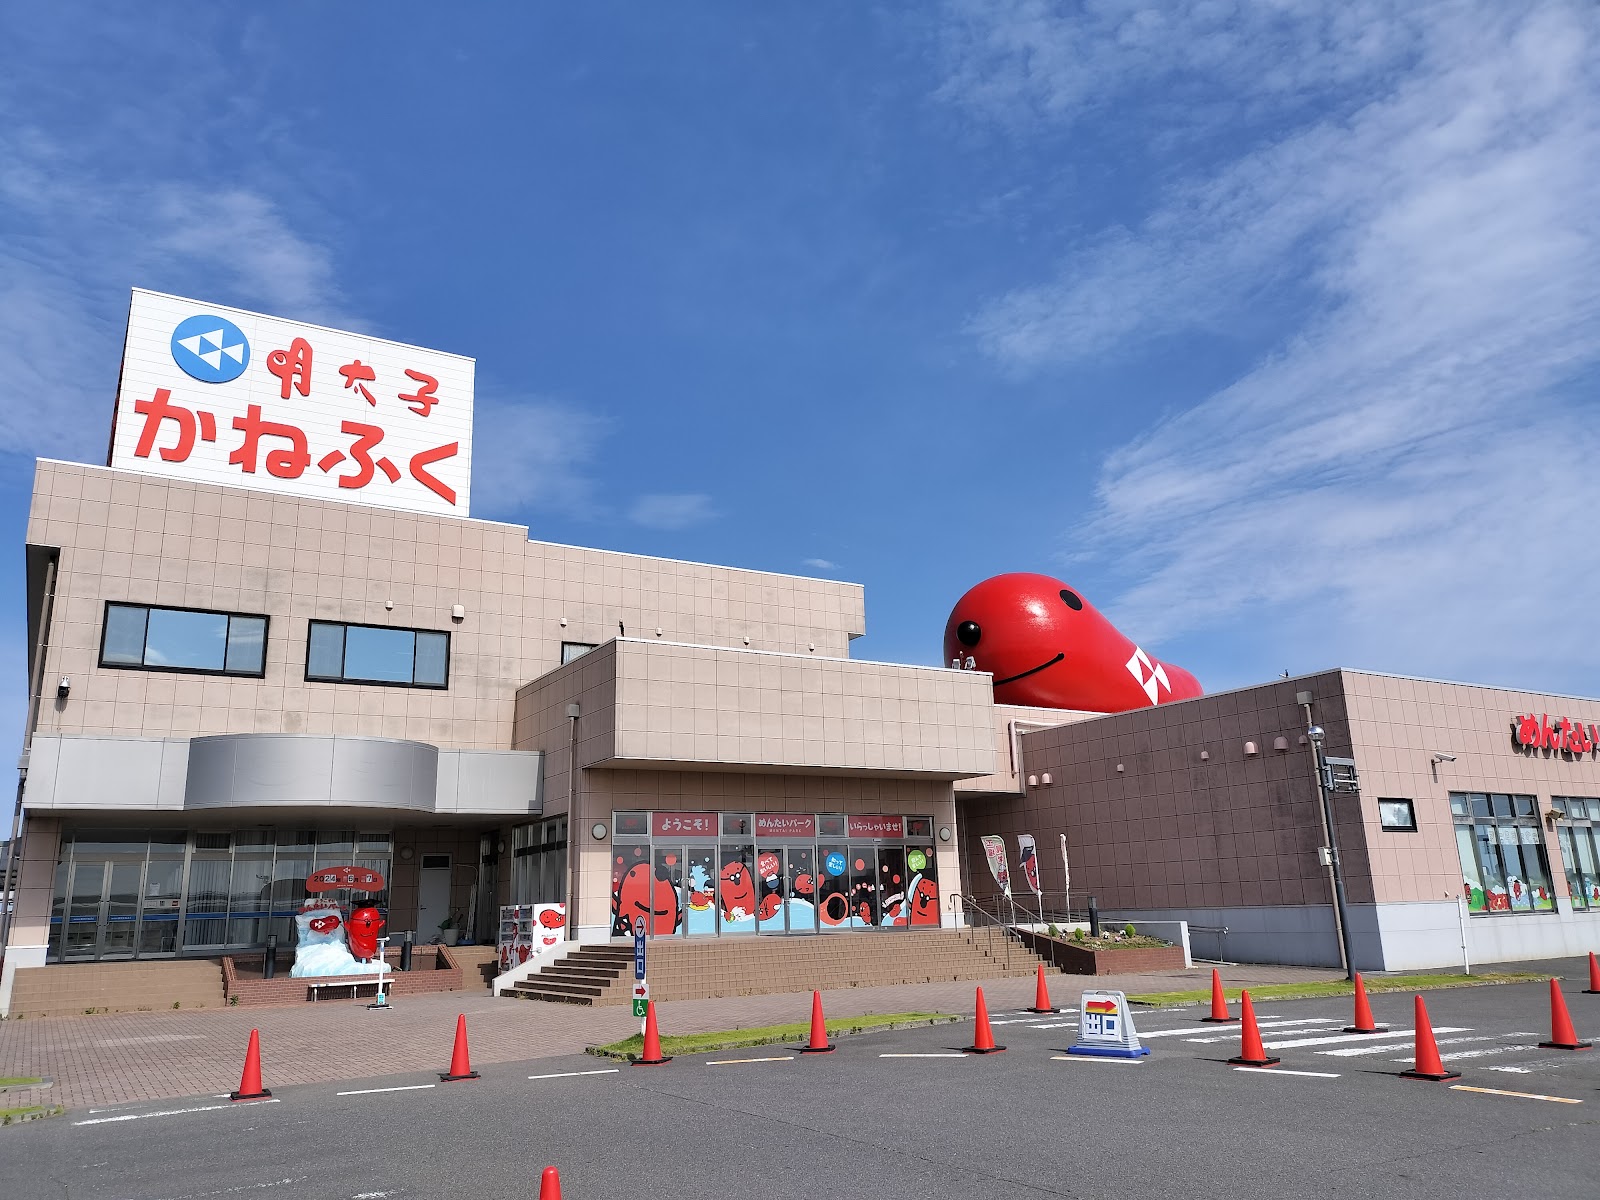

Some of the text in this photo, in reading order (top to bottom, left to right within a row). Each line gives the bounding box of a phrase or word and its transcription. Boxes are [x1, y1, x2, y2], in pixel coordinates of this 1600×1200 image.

[266, 337, 439, 417] 明太子
[134, 388, 459, 506] かねふく
[662, 818, 709, 831] ようこそ!
[758, 818, 811, 828] めんたいパーク
[850, 822, 901, 831] いらっしゃいませ!
[1085, 1013, 1118, 1035] 出口
